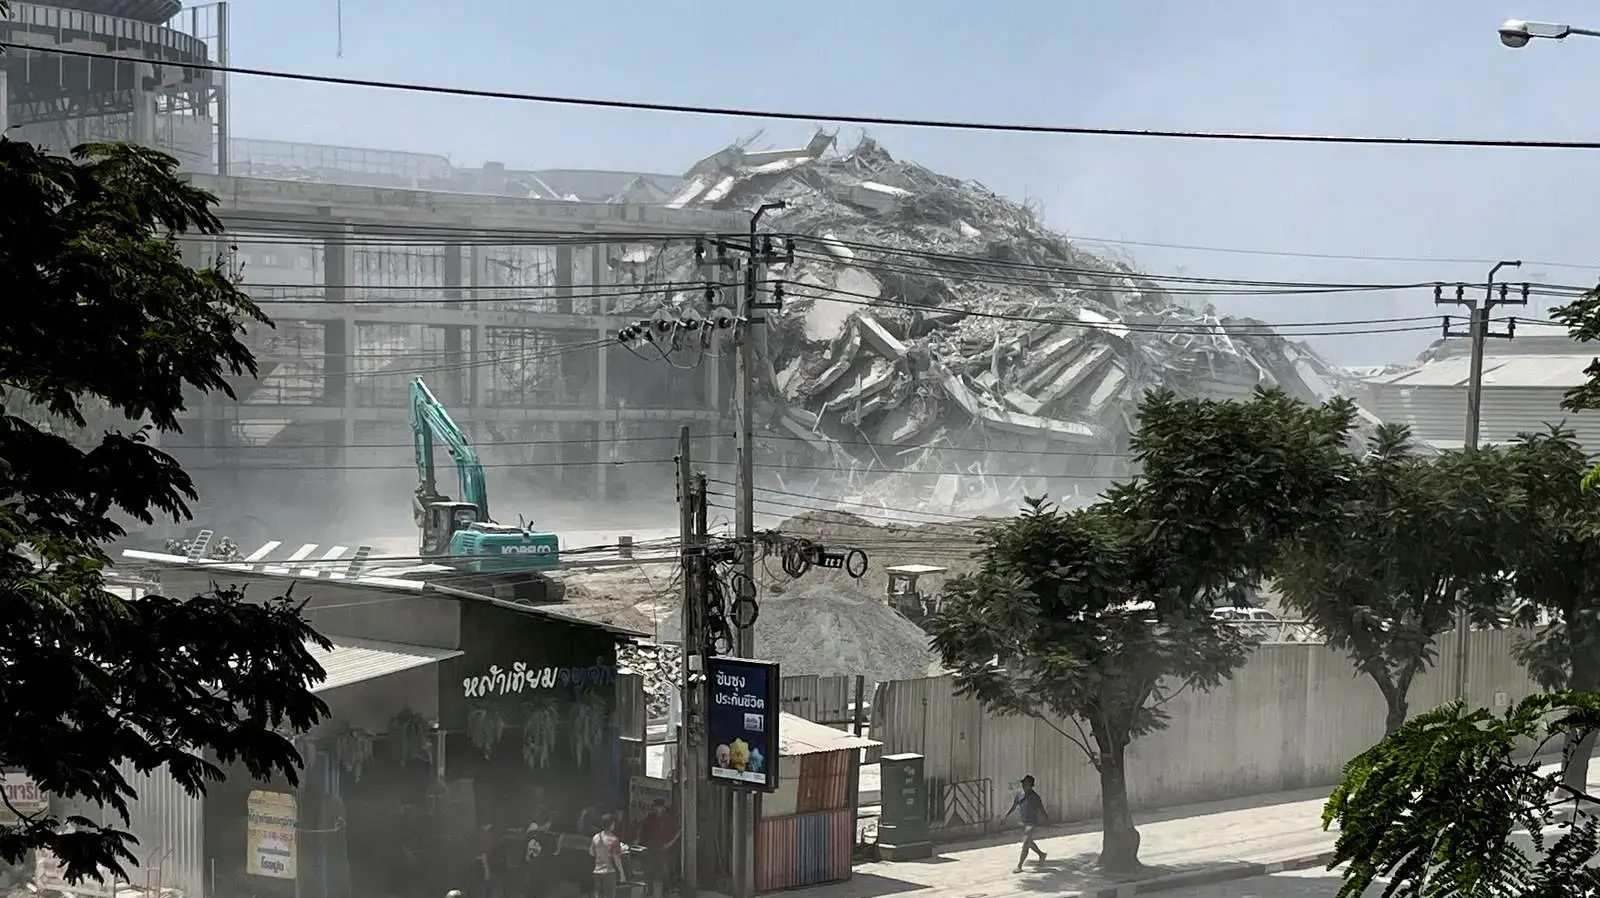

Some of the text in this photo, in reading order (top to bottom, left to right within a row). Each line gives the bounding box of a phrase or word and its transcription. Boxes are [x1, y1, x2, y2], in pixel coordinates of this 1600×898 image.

[715, 692, 765, 709] ประกันชีวิต
